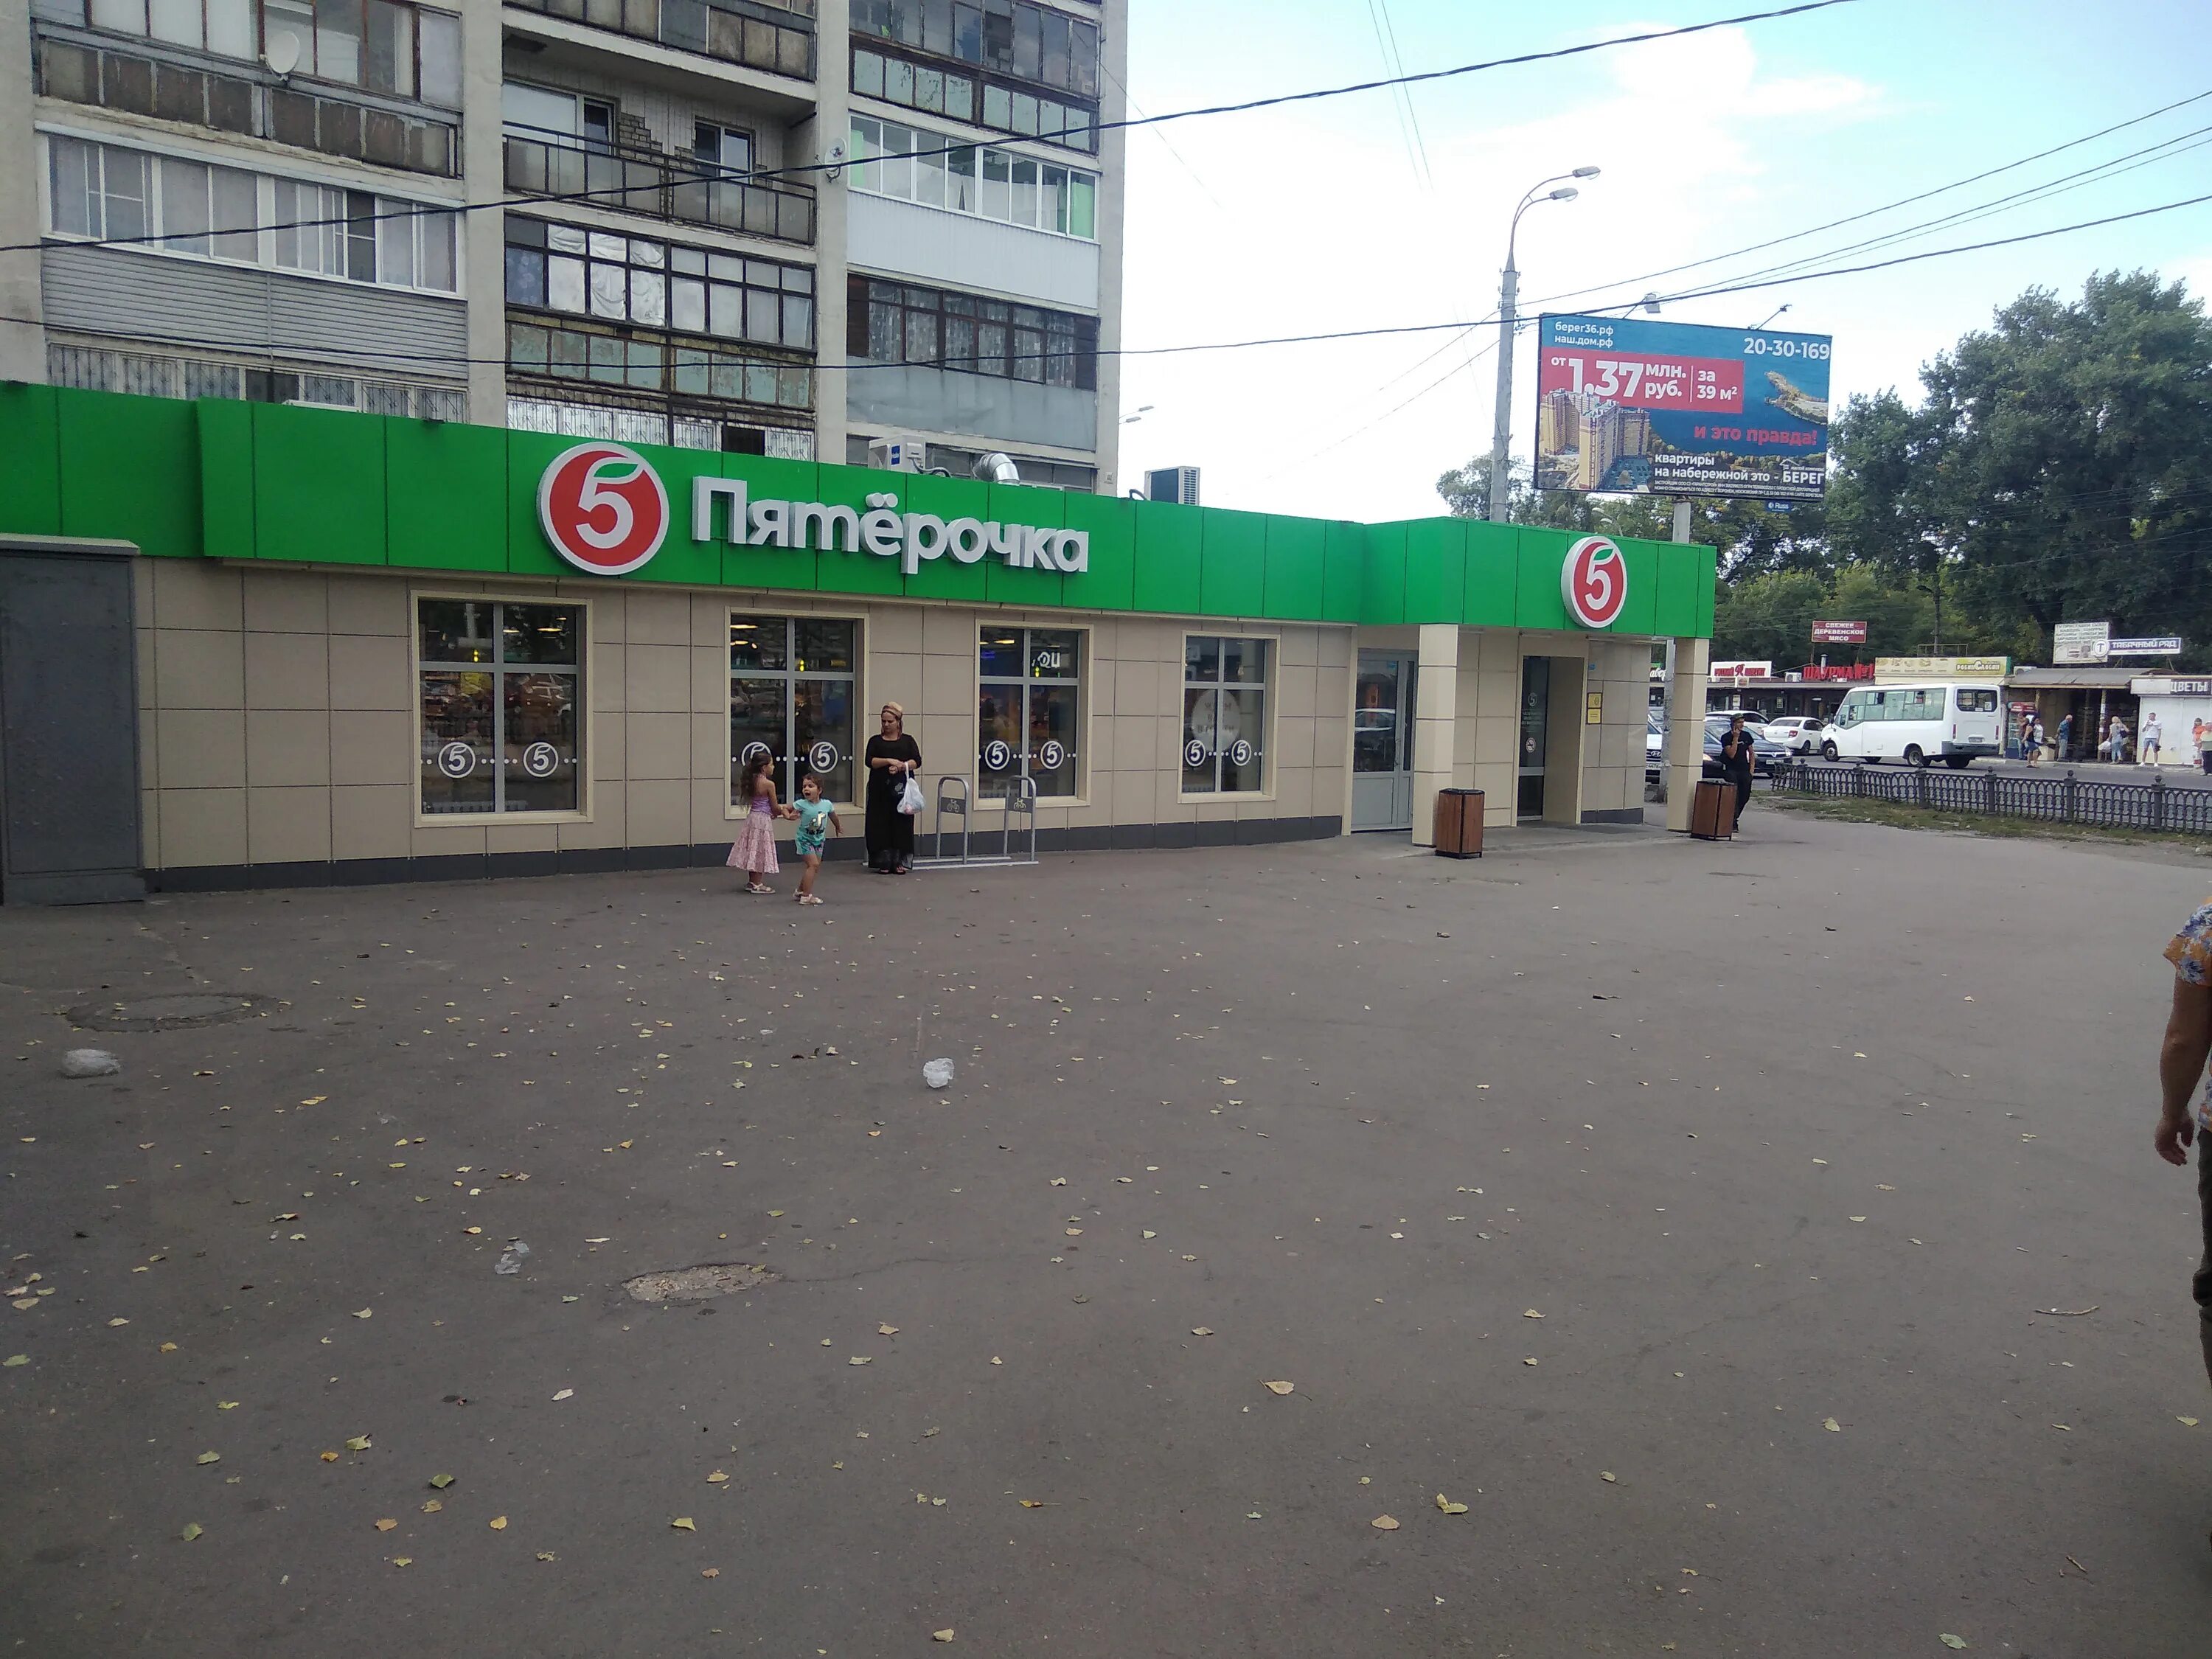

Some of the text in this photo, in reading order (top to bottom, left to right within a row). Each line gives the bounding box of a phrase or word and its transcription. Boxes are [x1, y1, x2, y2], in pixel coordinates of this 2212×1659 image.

[1555, 321, 1614, 336] берег36.рф
[1554, 335, 1613, 348] наш.дом.рф
[1744, 337, 1830, 360] 20-30-169
[1551, 357, 1567, 366] от
[1646, 364, 1686, 378] млн.
[1697, 370, 1716, 382] за
[1645, 380, 1683, 399] руб.
[1697, 385, 1717, 399] 39
[1694, 426, 1818, 446] и это правда!
[1655, 453, 1715, 467] квартиры
[1655, 467, 1669, 477] на
[1672, 466, 1748, 481] набережной
[1750, 472, 1770, 481] это
[1782, 470, 1825, 484] БЕРЕГ
[692, 476, 1089, 574] Пятёрочка
[2159, 640, 2177, 648] РЯД
[2171, 681, 2208, 693] ЦВЕТЫ
